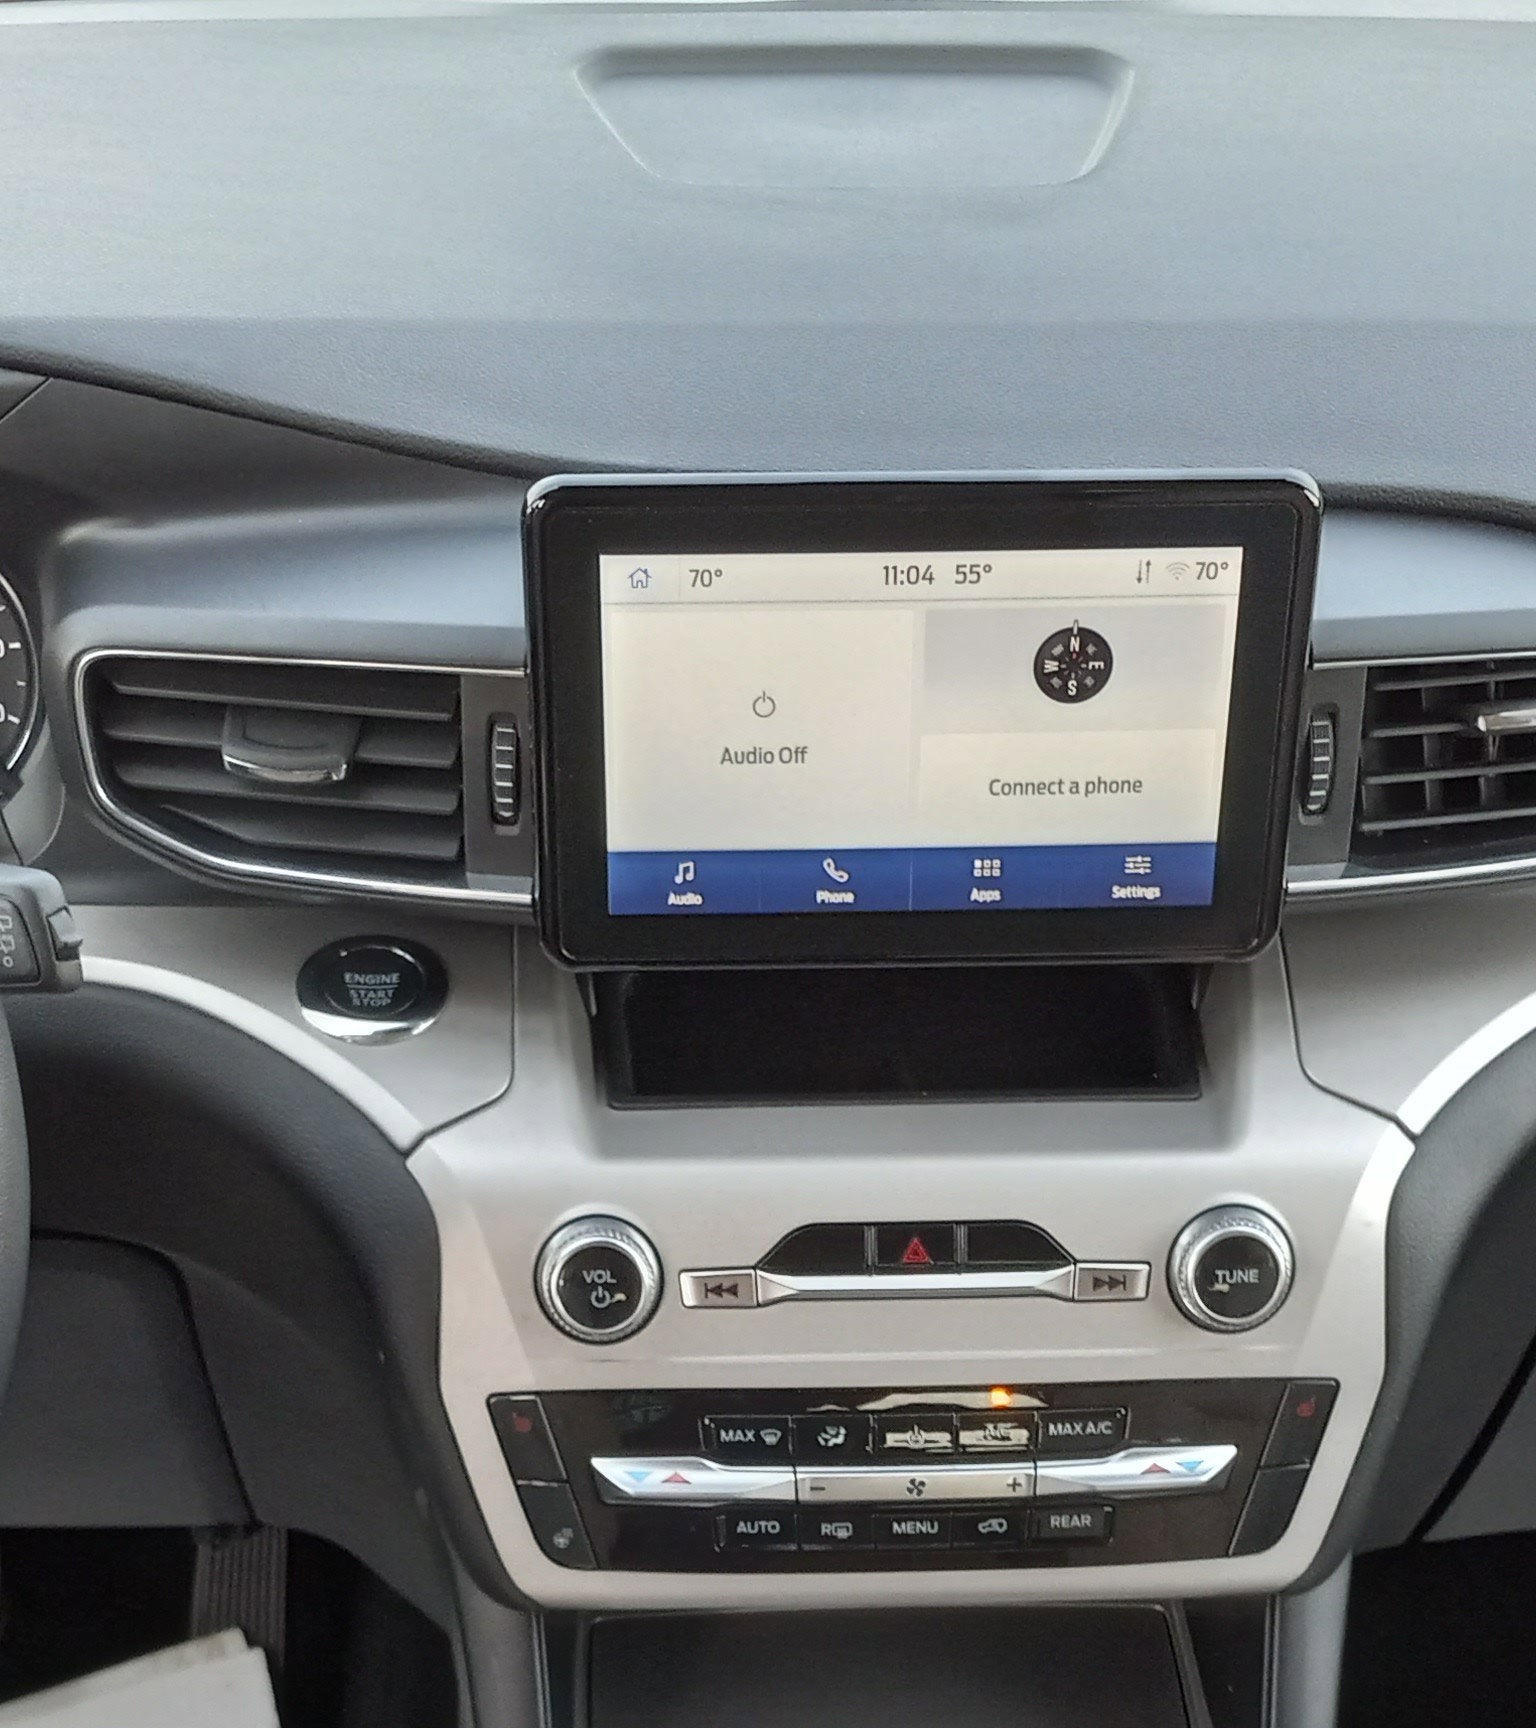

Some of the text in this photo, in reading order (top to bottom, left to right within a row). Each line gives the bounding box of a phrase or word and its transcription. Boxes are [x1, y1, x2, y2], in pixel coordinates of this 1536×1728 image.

[689, 568, 723, 589] 70°
[882, 563, 993, 586] 11:04 55°
[1196, 561, 1230, 581] 70°
[1069, 636, 1080, 652] N
[1044, 659, 1060, 673] W
[1088, 661, 1105, 671] E
[1067, 679, 1078, 696] S
[720, 744, 808, 765] Audio Off
[988, 774, 1143, 799] Connect a phone
[668, 890, 703, 905] Audio
[816, 889, 855, 904] Phone
[970, 887, 1001, 905] Apps
[1111, 884, 1161, 902] Settings
[344, 973, 400, 984] ENGINE
[350, 989, 394, 998] START
[582, 1268, 618, 1285] VOL
[1214, 1267, 1260, 1285] TUNE
[719, 1428, 756, 1443] MAX
[1049, 1419, 1113, 1437] MAX A/C
[736, 1519, 781, 1535] AUTO
[892, 1519, 939, 1535] MENU
[1049, 1513, 1093, 1528] REAR
